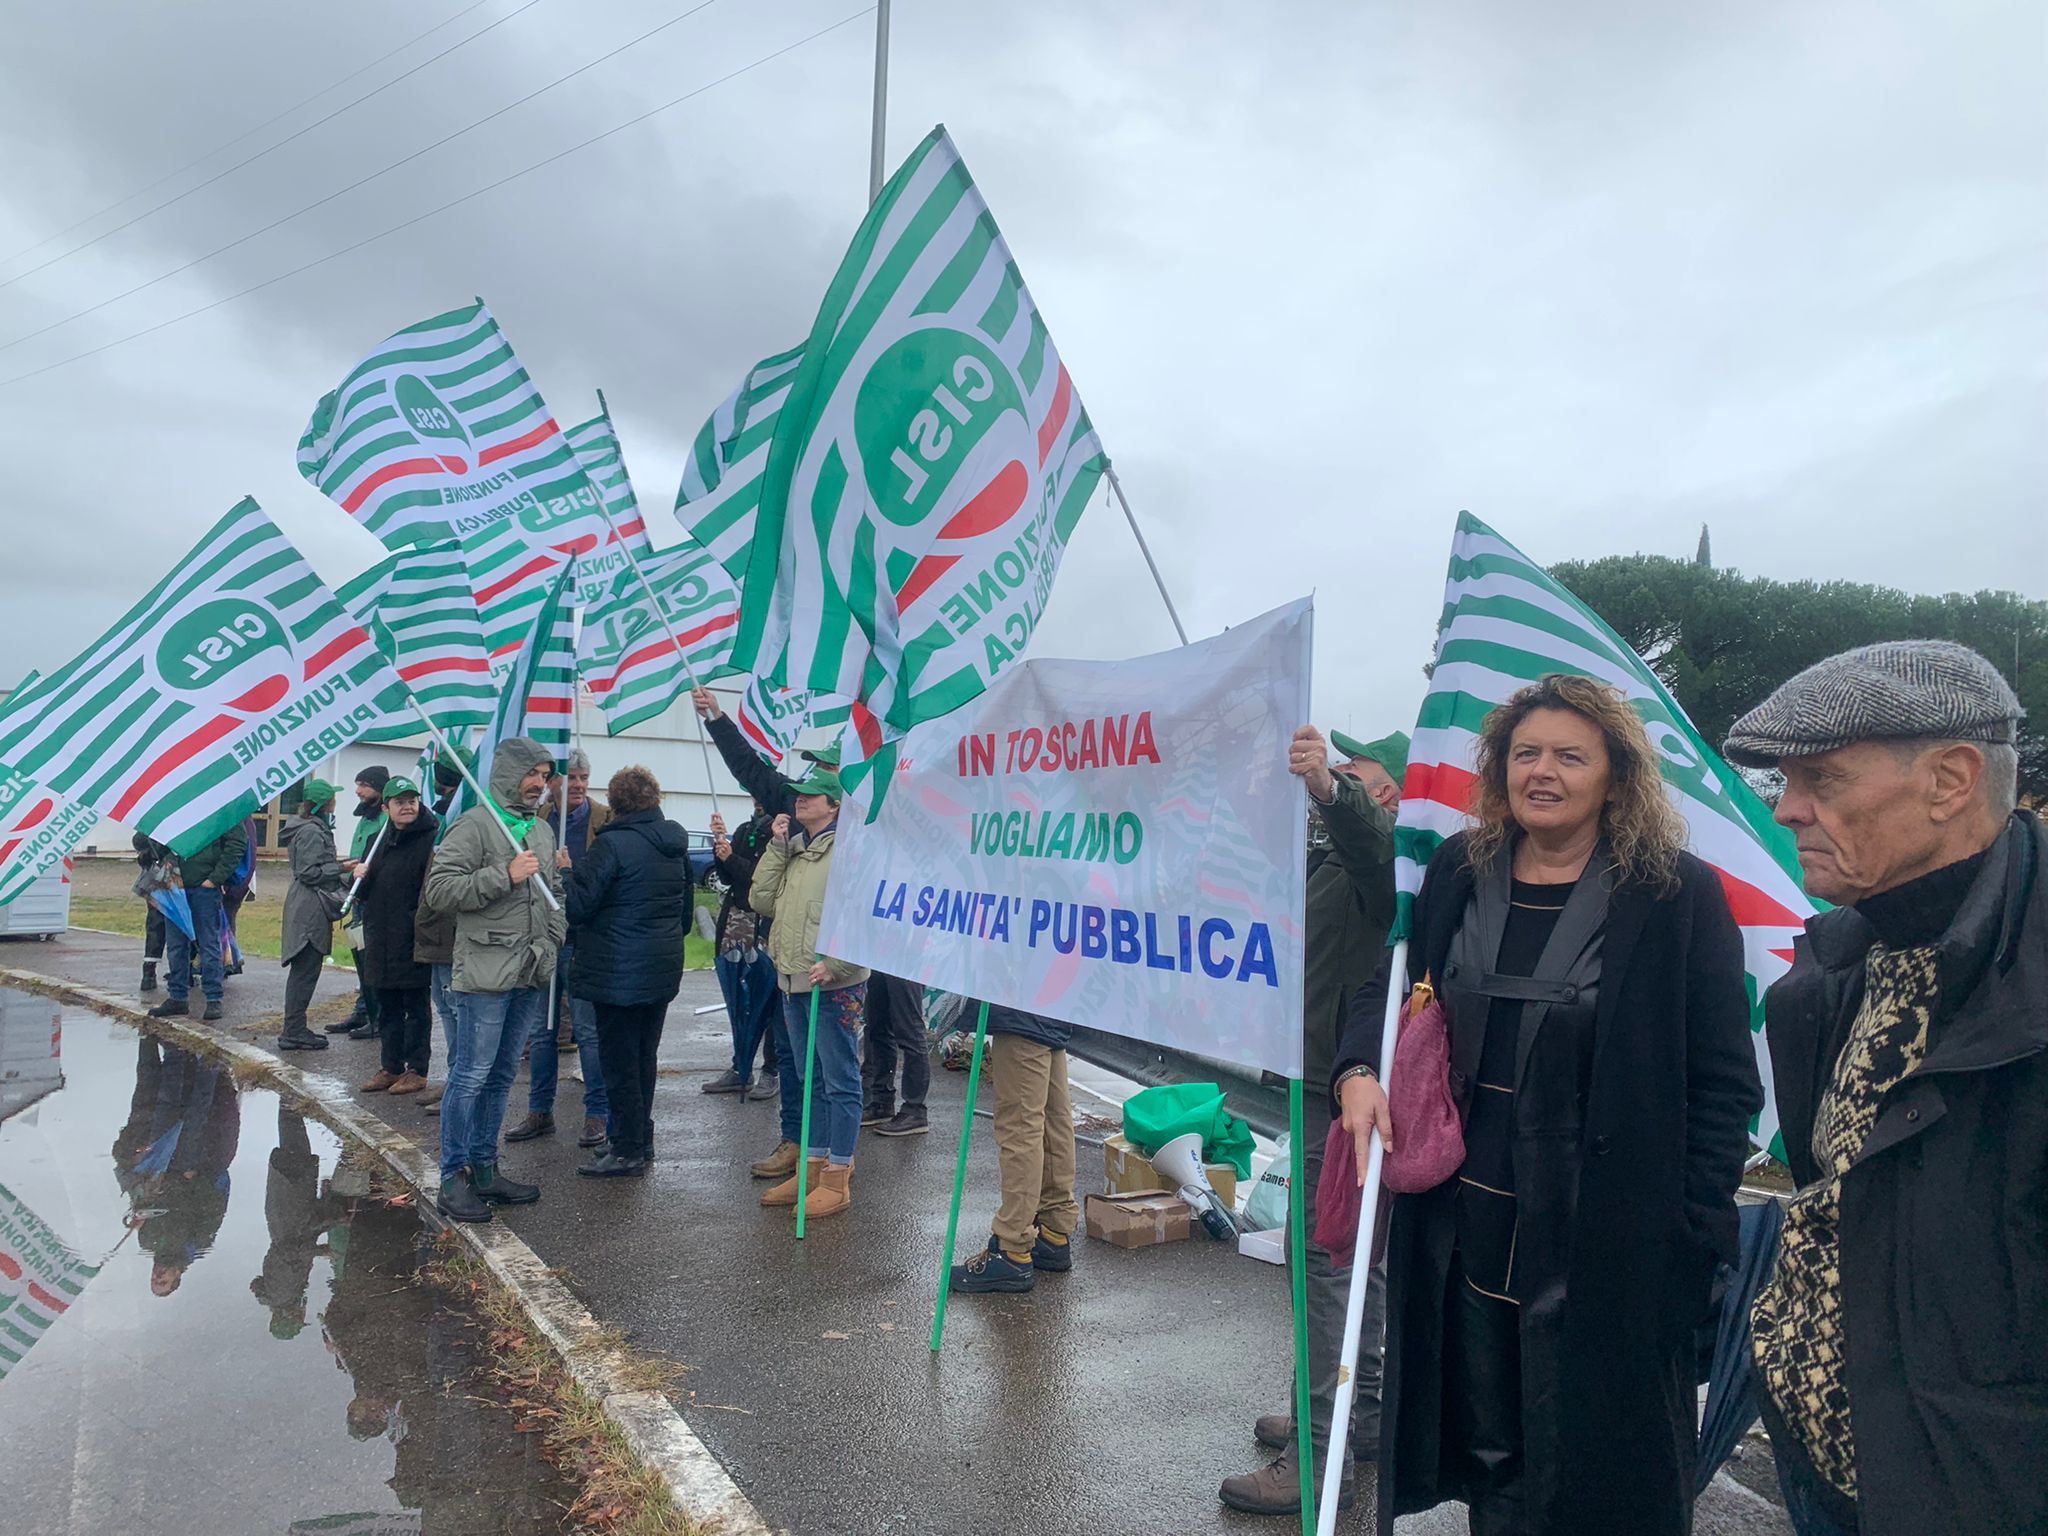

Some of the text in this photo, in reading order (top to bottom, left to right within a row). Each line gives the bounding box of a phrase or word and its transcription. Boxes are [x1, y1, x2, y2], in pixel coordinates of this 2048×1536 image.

[959, 711, 1161, 777] IN TOSCANA
[970, 811, 1143, 864] VOGLIAMO
[872, 880, 1278, 988] LA SANITA' PUBBLICA
